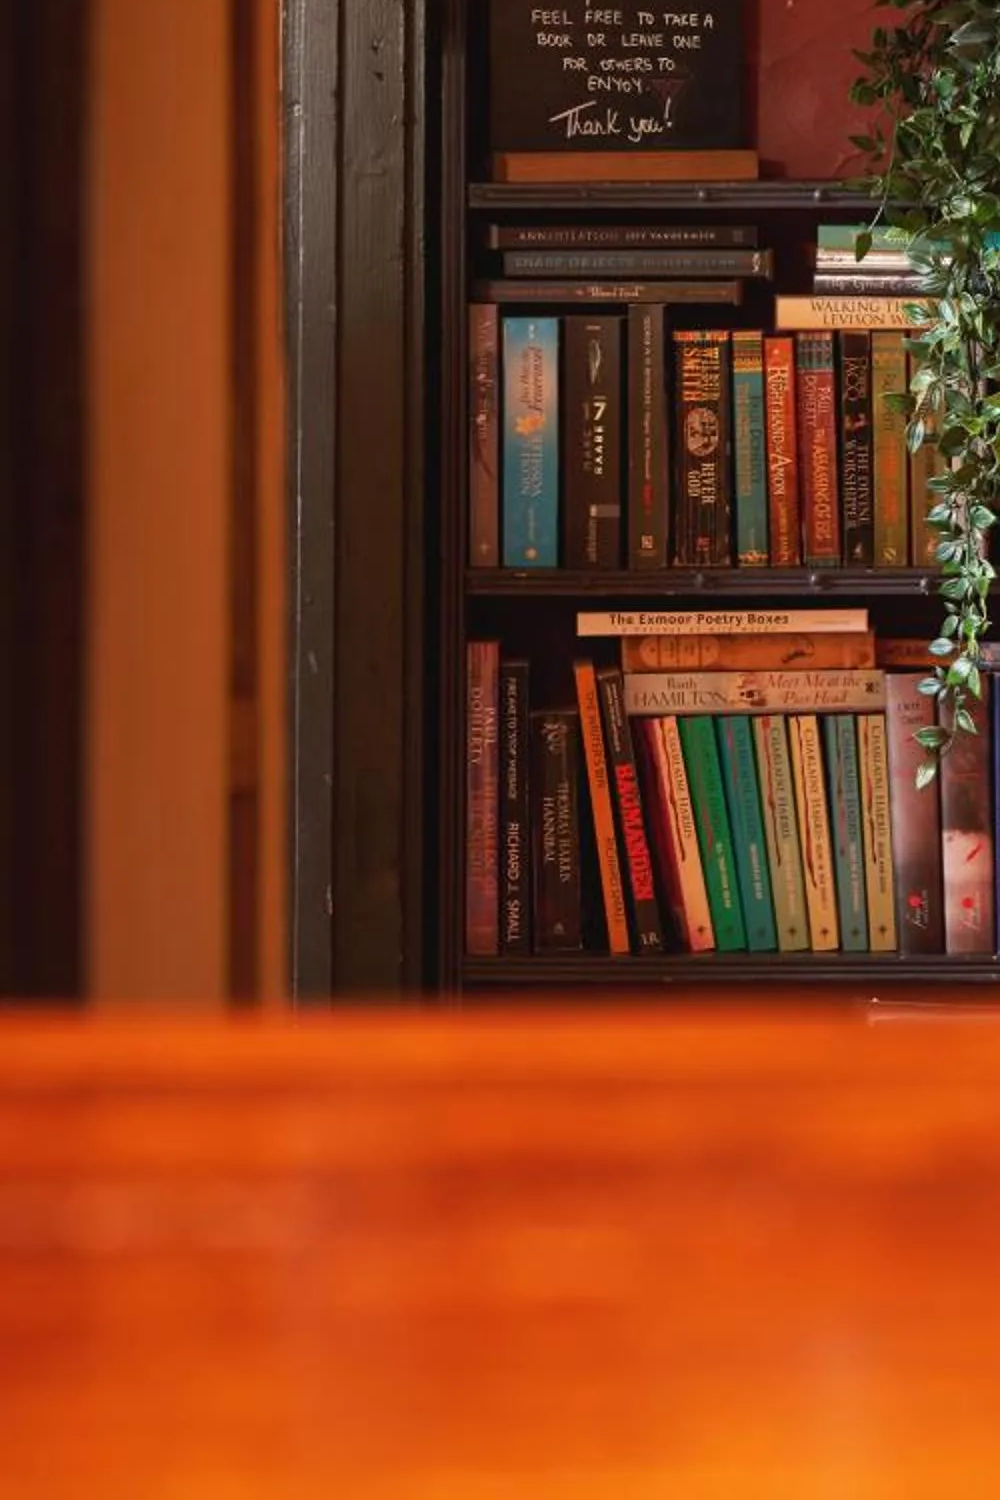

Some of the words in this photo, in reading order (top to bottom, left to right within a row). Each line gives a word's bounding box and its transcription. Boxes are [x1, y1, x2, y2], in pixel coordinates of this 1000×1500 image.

[531, 9, 573, 25] FEEL
[585, 10, 623, 26] FREE
[636, 11, 655, 25] TO
[662, 13, 700, 27] TAKE
[703, 14, 714, 29] A
[536, 32, 573, 47] BOOK
[586, 33, 607, 47] OR
[620, 33, 664, 47] LEAVE
[672, 35, 702, 49] ONE
[562, 57, 589, 71] FOR
[599, 57, 653, 72] OTHERS
[656, 57, 675, 71] TO
[546, 99, 621, 139] Thank
[628, 96, 673, 143] you!
[519, 231, 619, 243] ANNIHILATION
[811, 300, 885, 313] WALKING
[823, 314, 885, 326] LEVISON
[682, 347, 702, 402] SMITH
[702, 346, 721, 401] WILBUR
[767, 367, 789, 408] RIGHT
[804, 375, 818, 426] DOHERTY
[817, 387, 831, 414] PAUL
[771, 409, 785, 443] HAND
[770, 453, 793, 495] AMON
[857, 443, 871, 474] THE
[688, 470, 700, 498] GOD
[701, 463, 717, 504] RIVER
[844, 438, 858, 531] WORSHIPPER
[857, 476, 872, 524] DIVINE
[609, 613, 634, 625] The
[638, 613, 692, 625] Exmoor
[697, 614, 744, 627] Poetry
[747, 613, 790, 625] Boxes
[633, 689, 728, 707] HAMILTON
[666, 677, 698, 690] Ruth
[767, 674, 800, 689] Meet
[803, 674, 826, 688] Me
[470, 687, 484, 765] DOHERTY
[484, 706, 496, 746] PAUL
[770, 726, 785, 791] CHARLAINE
[870, 725, 884, 790] CHARLAINE
[803, 728, 819, 794] CHARLAINE
[812, 798, 824, 841] HARRIS
[556, 780, 569, 835] THOMAS
[777, 796, 791, 839] HARRIS
[875, 795, 887, 837] HARRIS
[507, 822, 519, 880] RICHARD
[543, 797, 555, 864] HANNIBAL
[558, 838, 571, 883] HARRIS
[507, 899, 521, 942] SMALL
